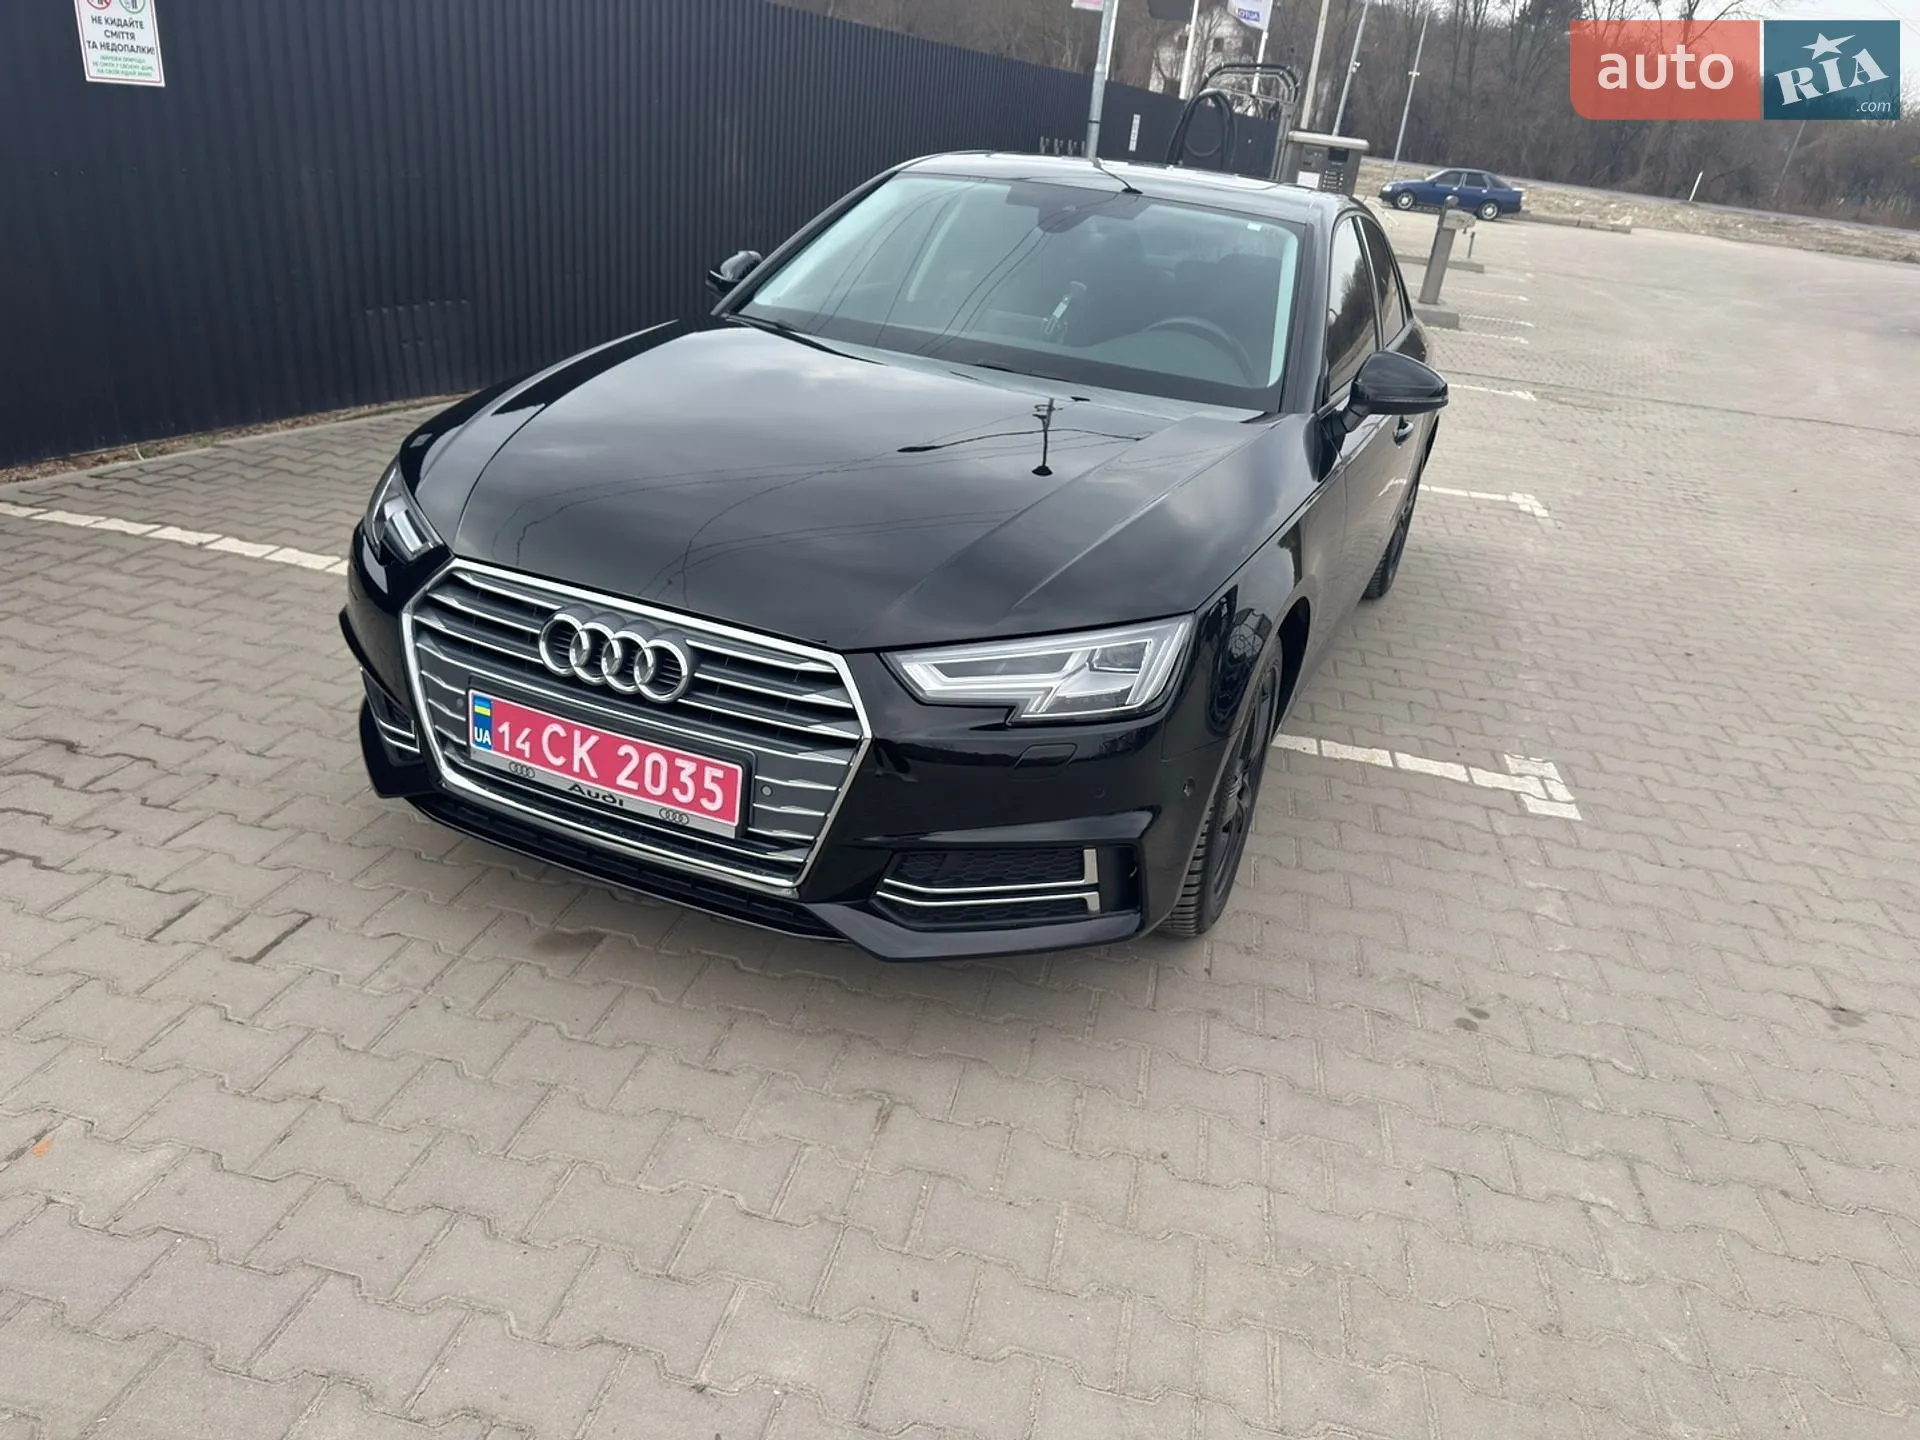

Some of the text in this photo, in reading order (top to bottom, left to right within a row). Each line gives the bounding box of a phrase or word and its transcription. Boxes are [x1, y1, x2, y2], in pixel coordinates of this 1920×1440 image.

[91, 16, 144, 29] НЕ КИДАЙТЕ
[104, 29, 136, 41] СМІТТЯ
[86, 40, 155, 55] ТА НЕДОПАЛКИ!
[474, 726, 492, 746] UA
[615, 744, 725, 812] 2035
[568, 783, 624, 806] Audi
